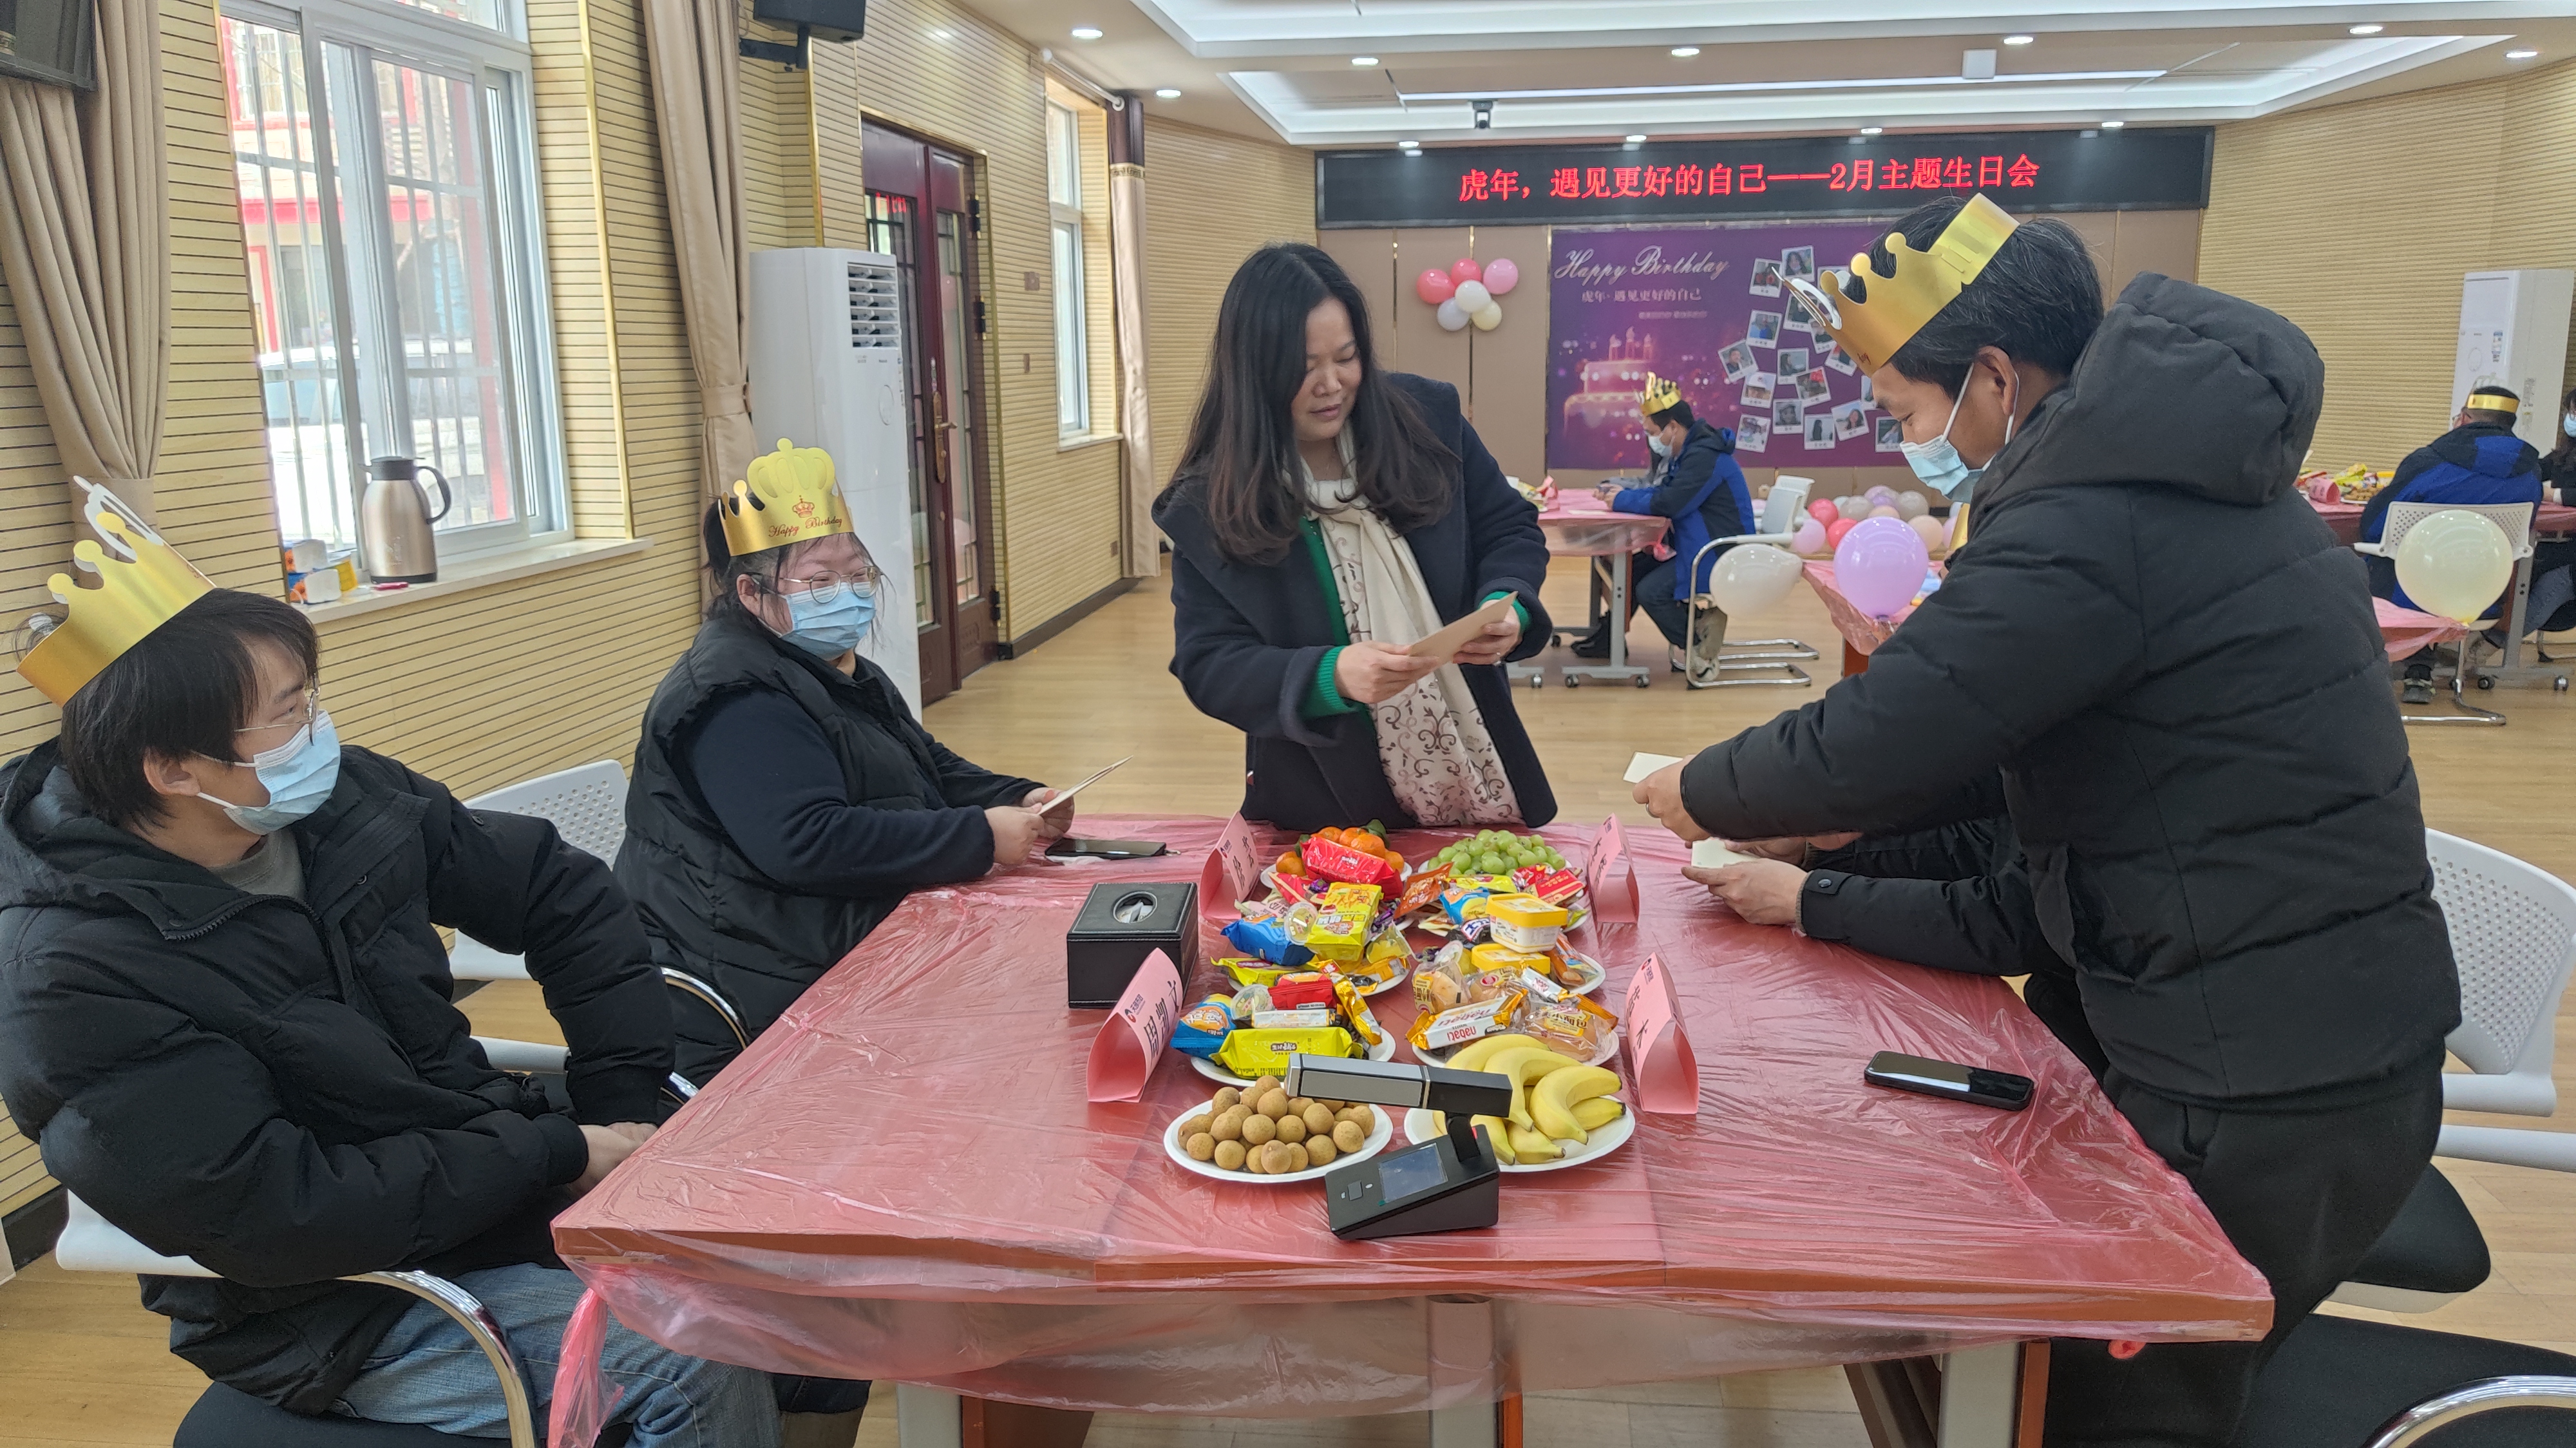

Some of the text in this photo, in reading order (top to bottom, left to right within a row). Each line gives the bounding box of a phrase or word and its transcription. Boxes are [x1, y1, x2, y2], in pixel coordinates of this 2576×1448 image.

[1459, 154, 2041, 203] 虎年，遇见更好的自己——2月主题生日会
[1554, 245, 1730, 285] Happy Birthday
[768, 515, 842, 538] Happy Birthday
[1144, 980, 1179, 1064] 周凯文
[1446, 1025, 1477, 1042] nabati
